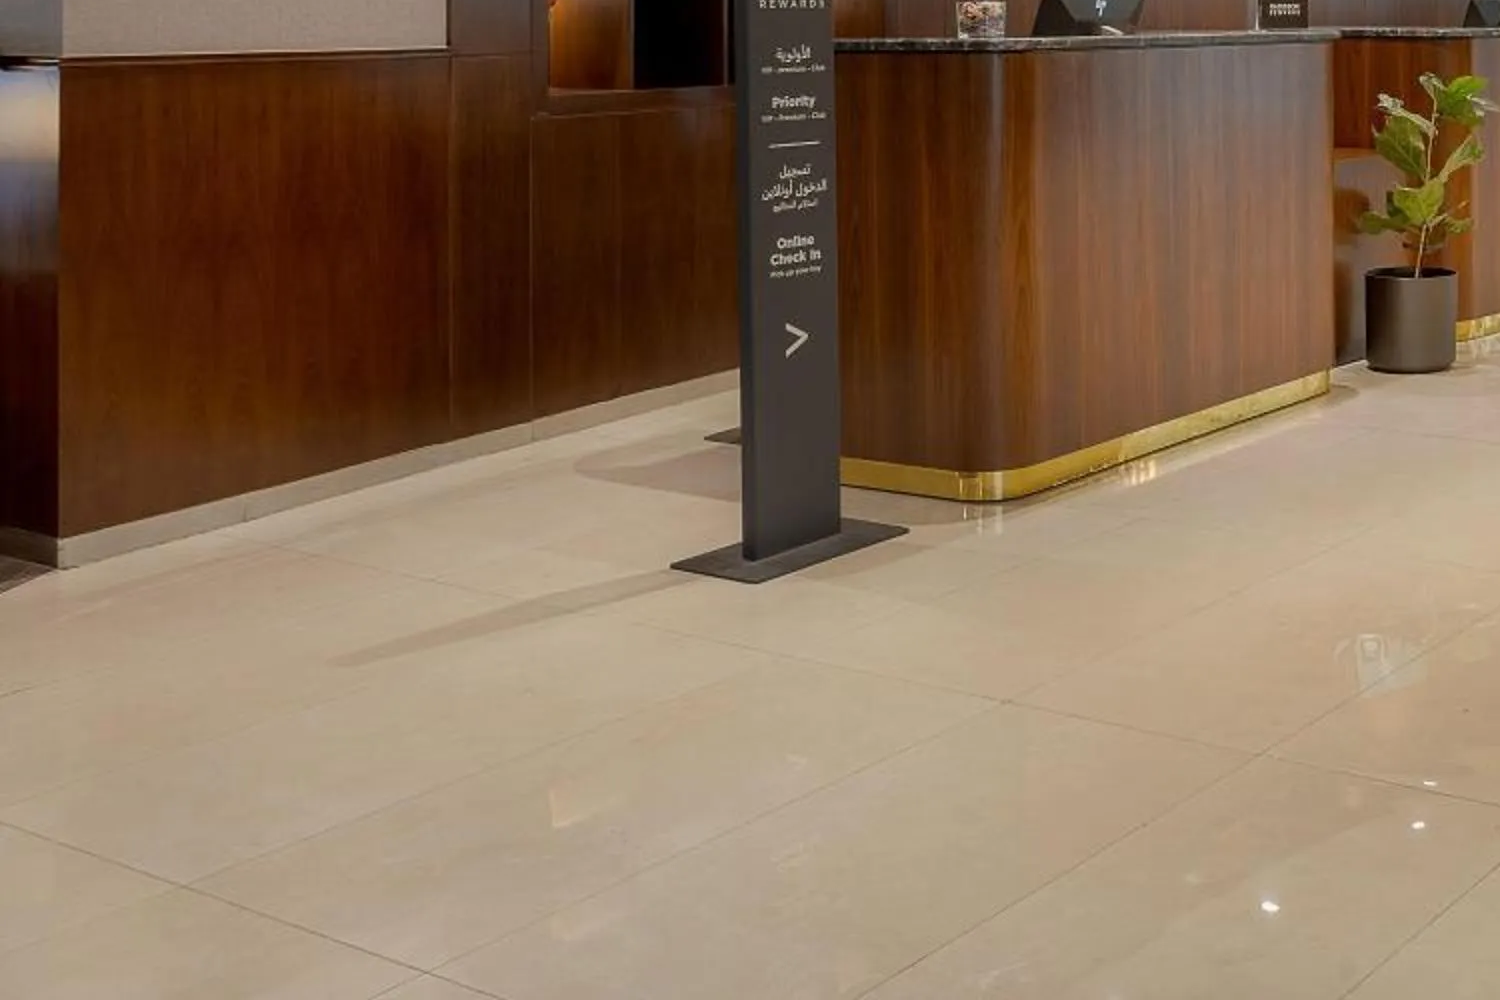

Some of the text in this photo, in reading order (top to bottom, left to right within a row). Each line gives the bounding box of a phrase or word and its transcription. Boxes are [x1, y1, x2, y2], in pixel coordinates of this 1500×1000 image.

[759, 0, 825, 9] REWARDS
[771, 95, 817, 109] Priority
[777, 236, 815, 249] Online
[770, 250, 807, 266] Check
